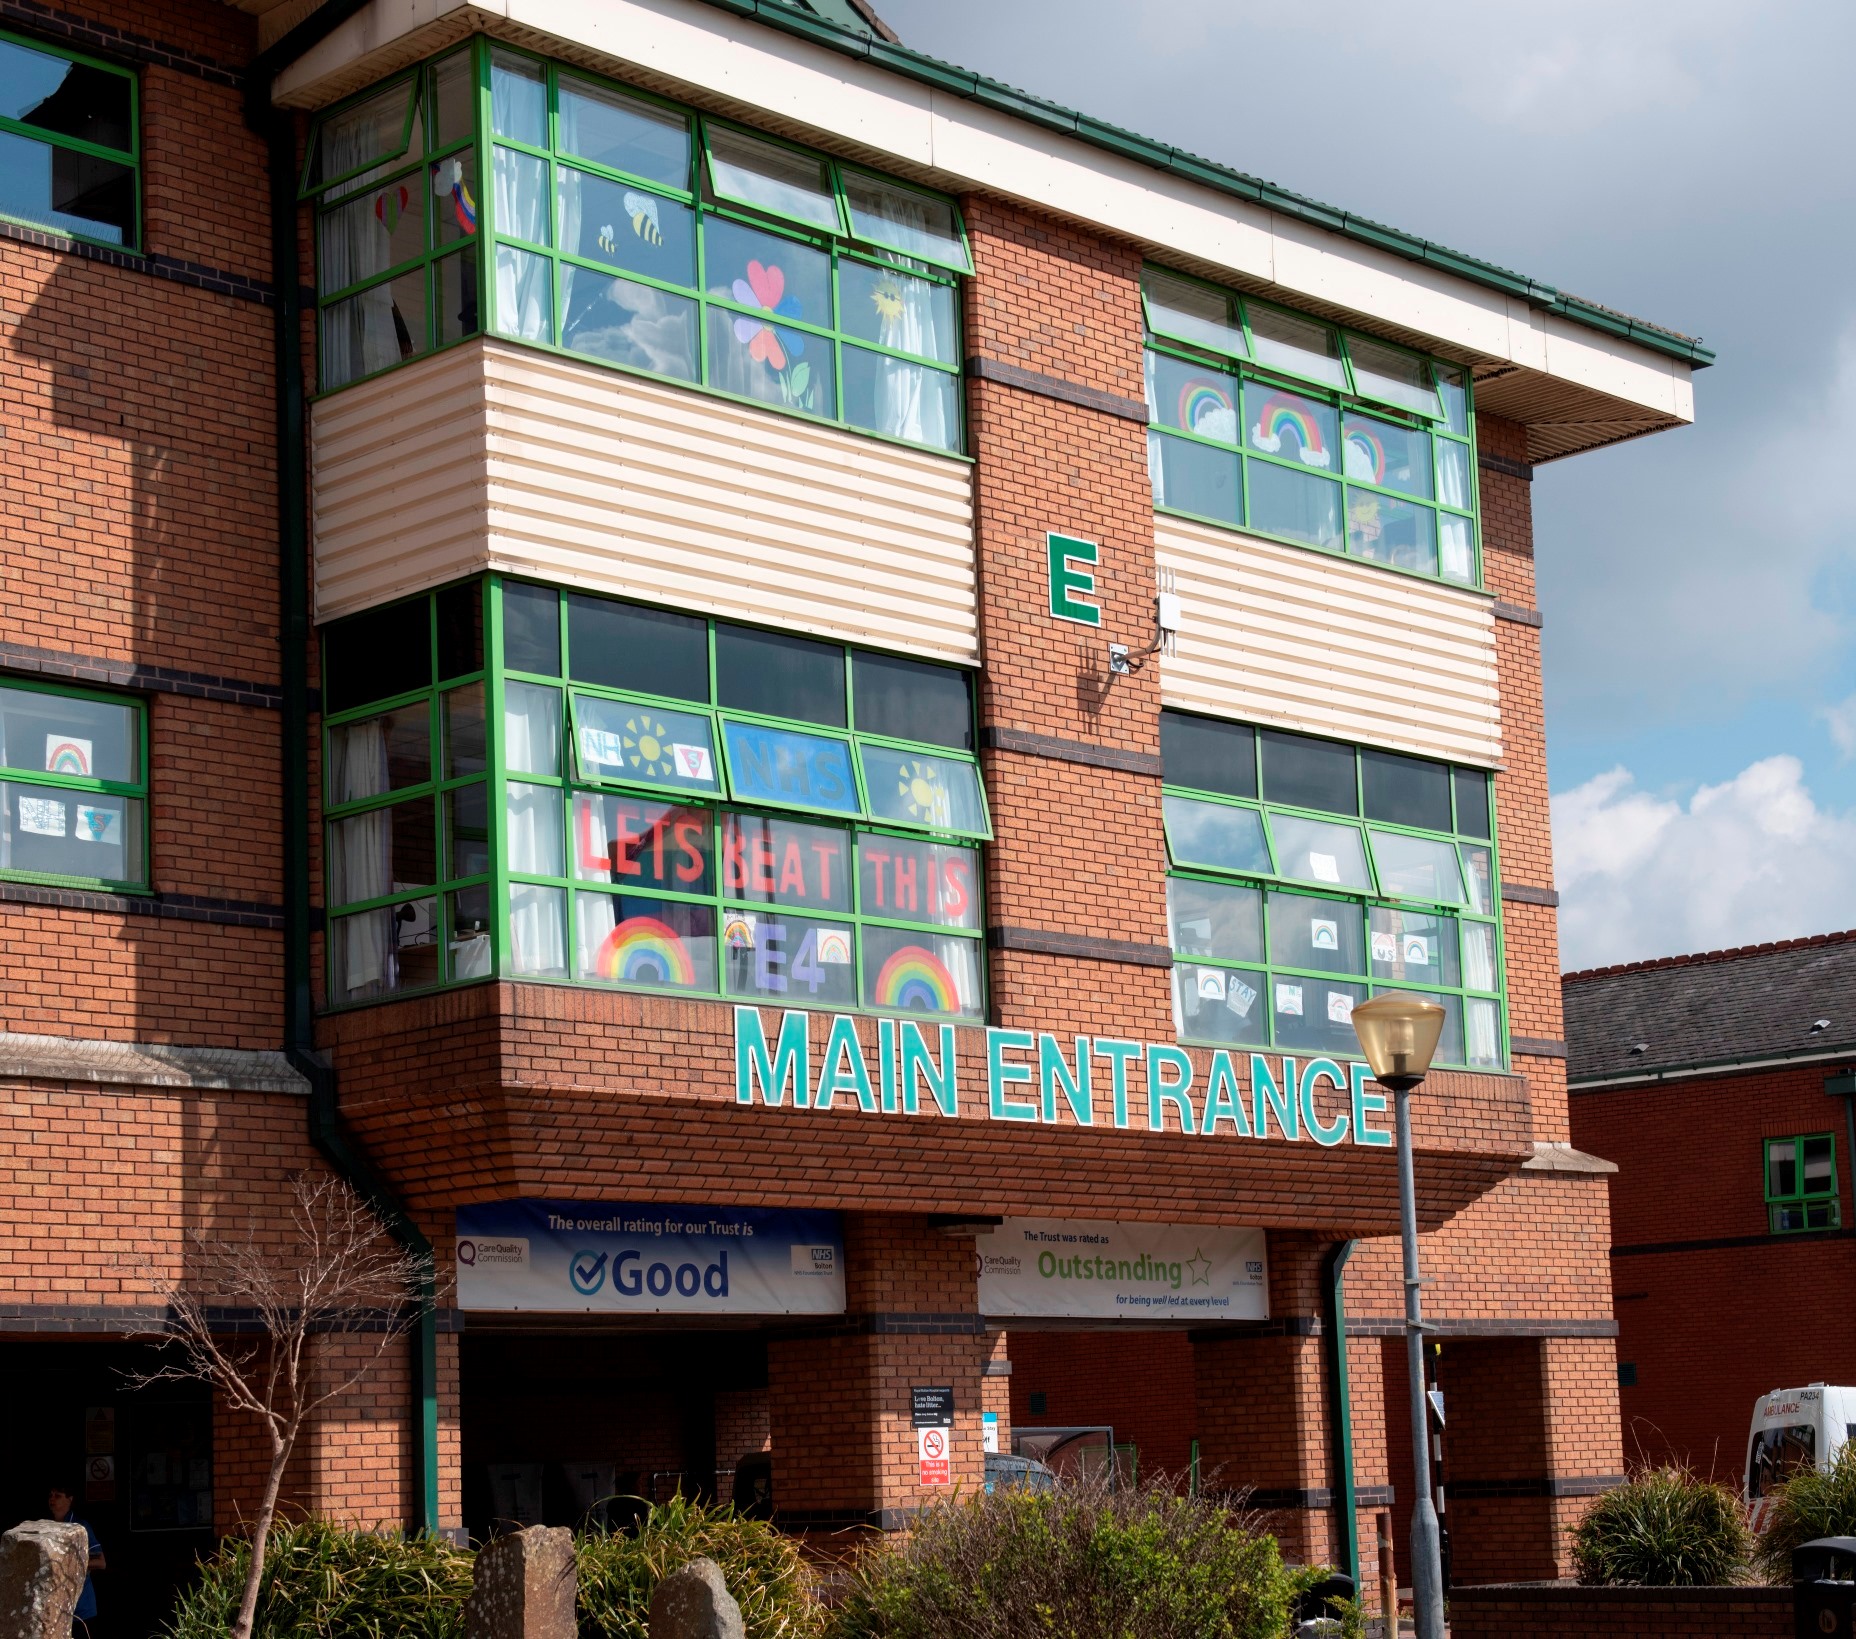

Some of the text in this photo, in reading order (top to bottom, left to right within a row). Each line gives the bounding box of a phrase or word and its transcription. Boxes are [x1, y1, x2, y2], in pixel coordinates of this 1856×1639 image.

[1047, 531, 1101, 628] E
[738, 735, 845, 799] NHS
[581, 799, 969, 917] LETS BEAT THIS
[755, 922, 826, 993] E4
[1230, 977, 1256, 1001] STAY
[734, 1005, 1392, 1148] MAIN ENTRANCE
[548, 1215, 754, 1236] The overall rating for our Trust is
[1024, 1231, 1038, 1241] The
[1040, 1232, 1060, 1242] Trust
[1079, 1234, 1099, 1243] rated
[1101, 1236, 1109, 1244] as
[478, 1253, 522, 1263] Commission
[812, 1249, 832, 1260] NHS
[612, 1250, 729, 1298] Good
[985, 1265, 1021, 1275] Commission
[1038, 1250, 1182, 1290] Outstanding
[1246, 1262, 1262, 1272] NHS
[1116, 1294, 1229, 1307] for being well led at every level
[1800, 1391, 1820, 1400] PA234
[1763, 1402, 1800, 1417] AMBULANCE
